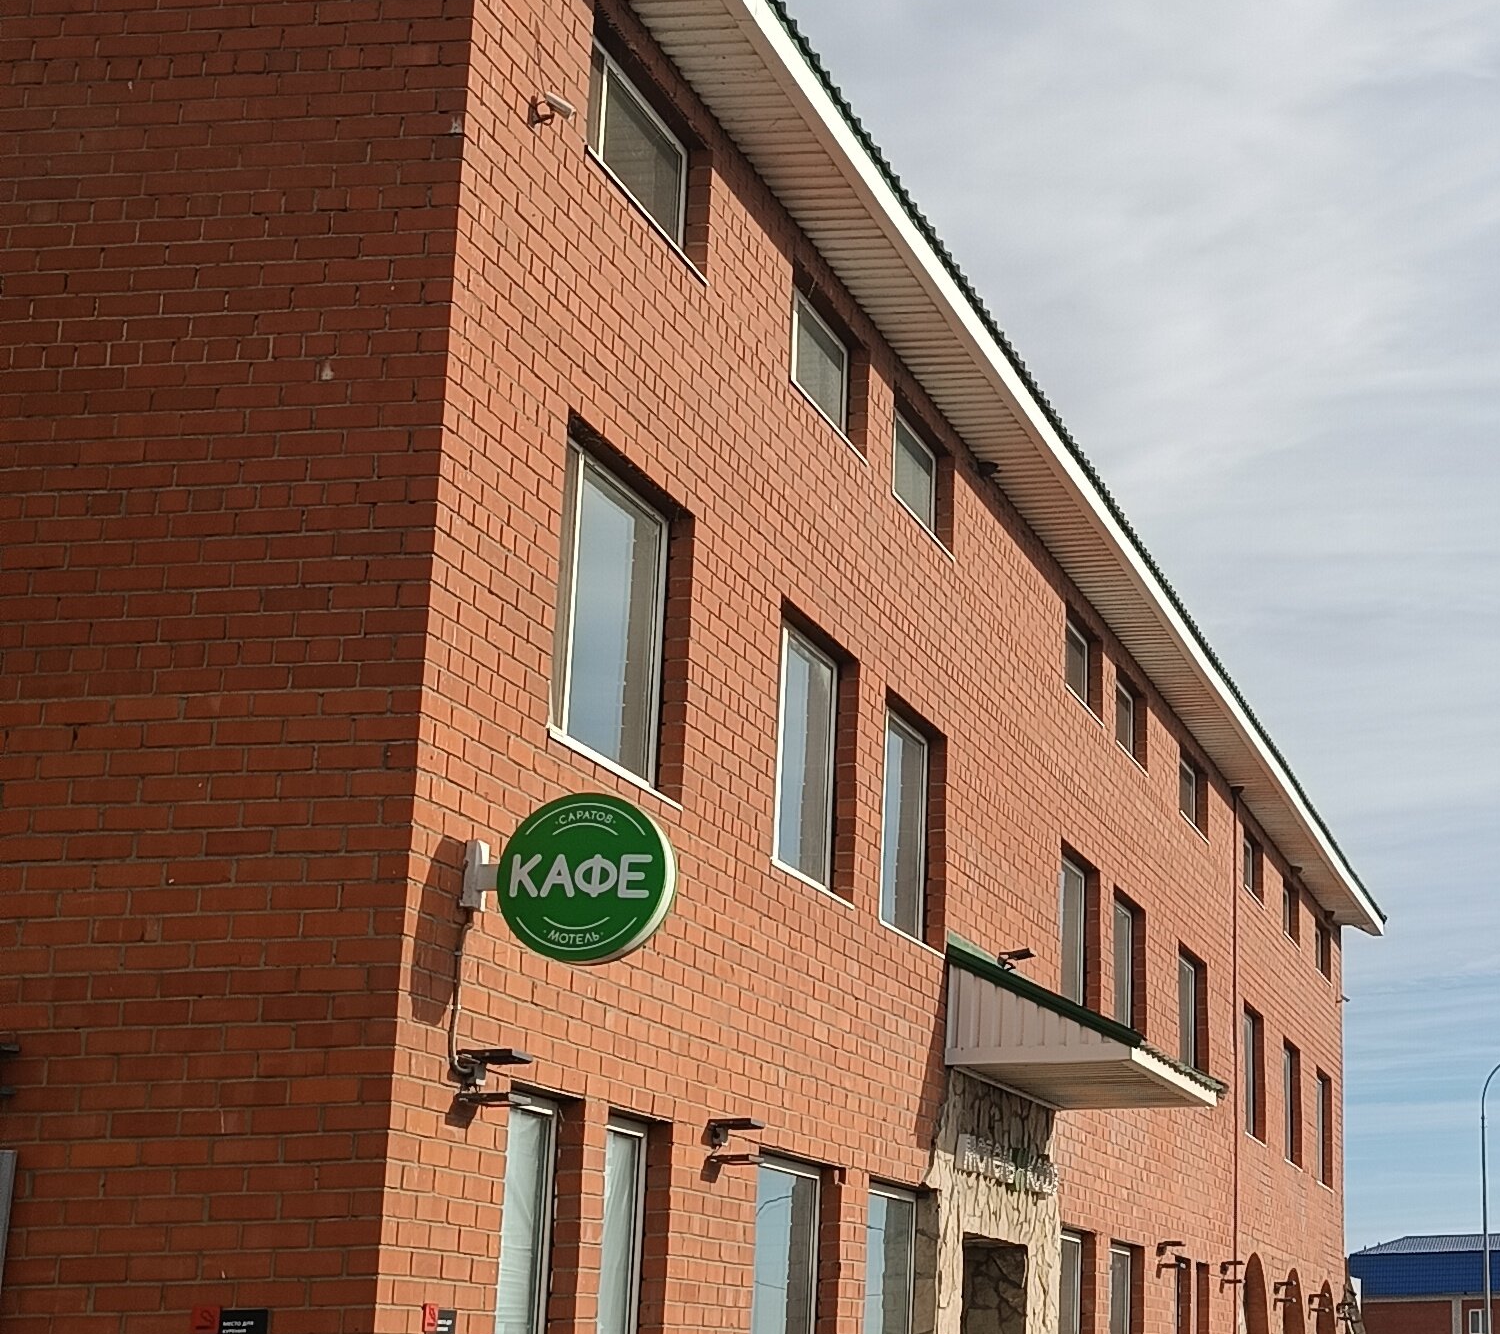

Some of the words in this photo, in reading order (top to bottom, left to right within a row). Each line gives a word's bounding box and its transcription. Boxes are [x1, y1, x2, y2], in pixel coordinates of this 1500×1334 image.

[558, 810, 614, 825] САРАТОВ
[508, 853, 653, 899] КАФЕ
[547, 929, 600, 945] МОТЕЛЬ
